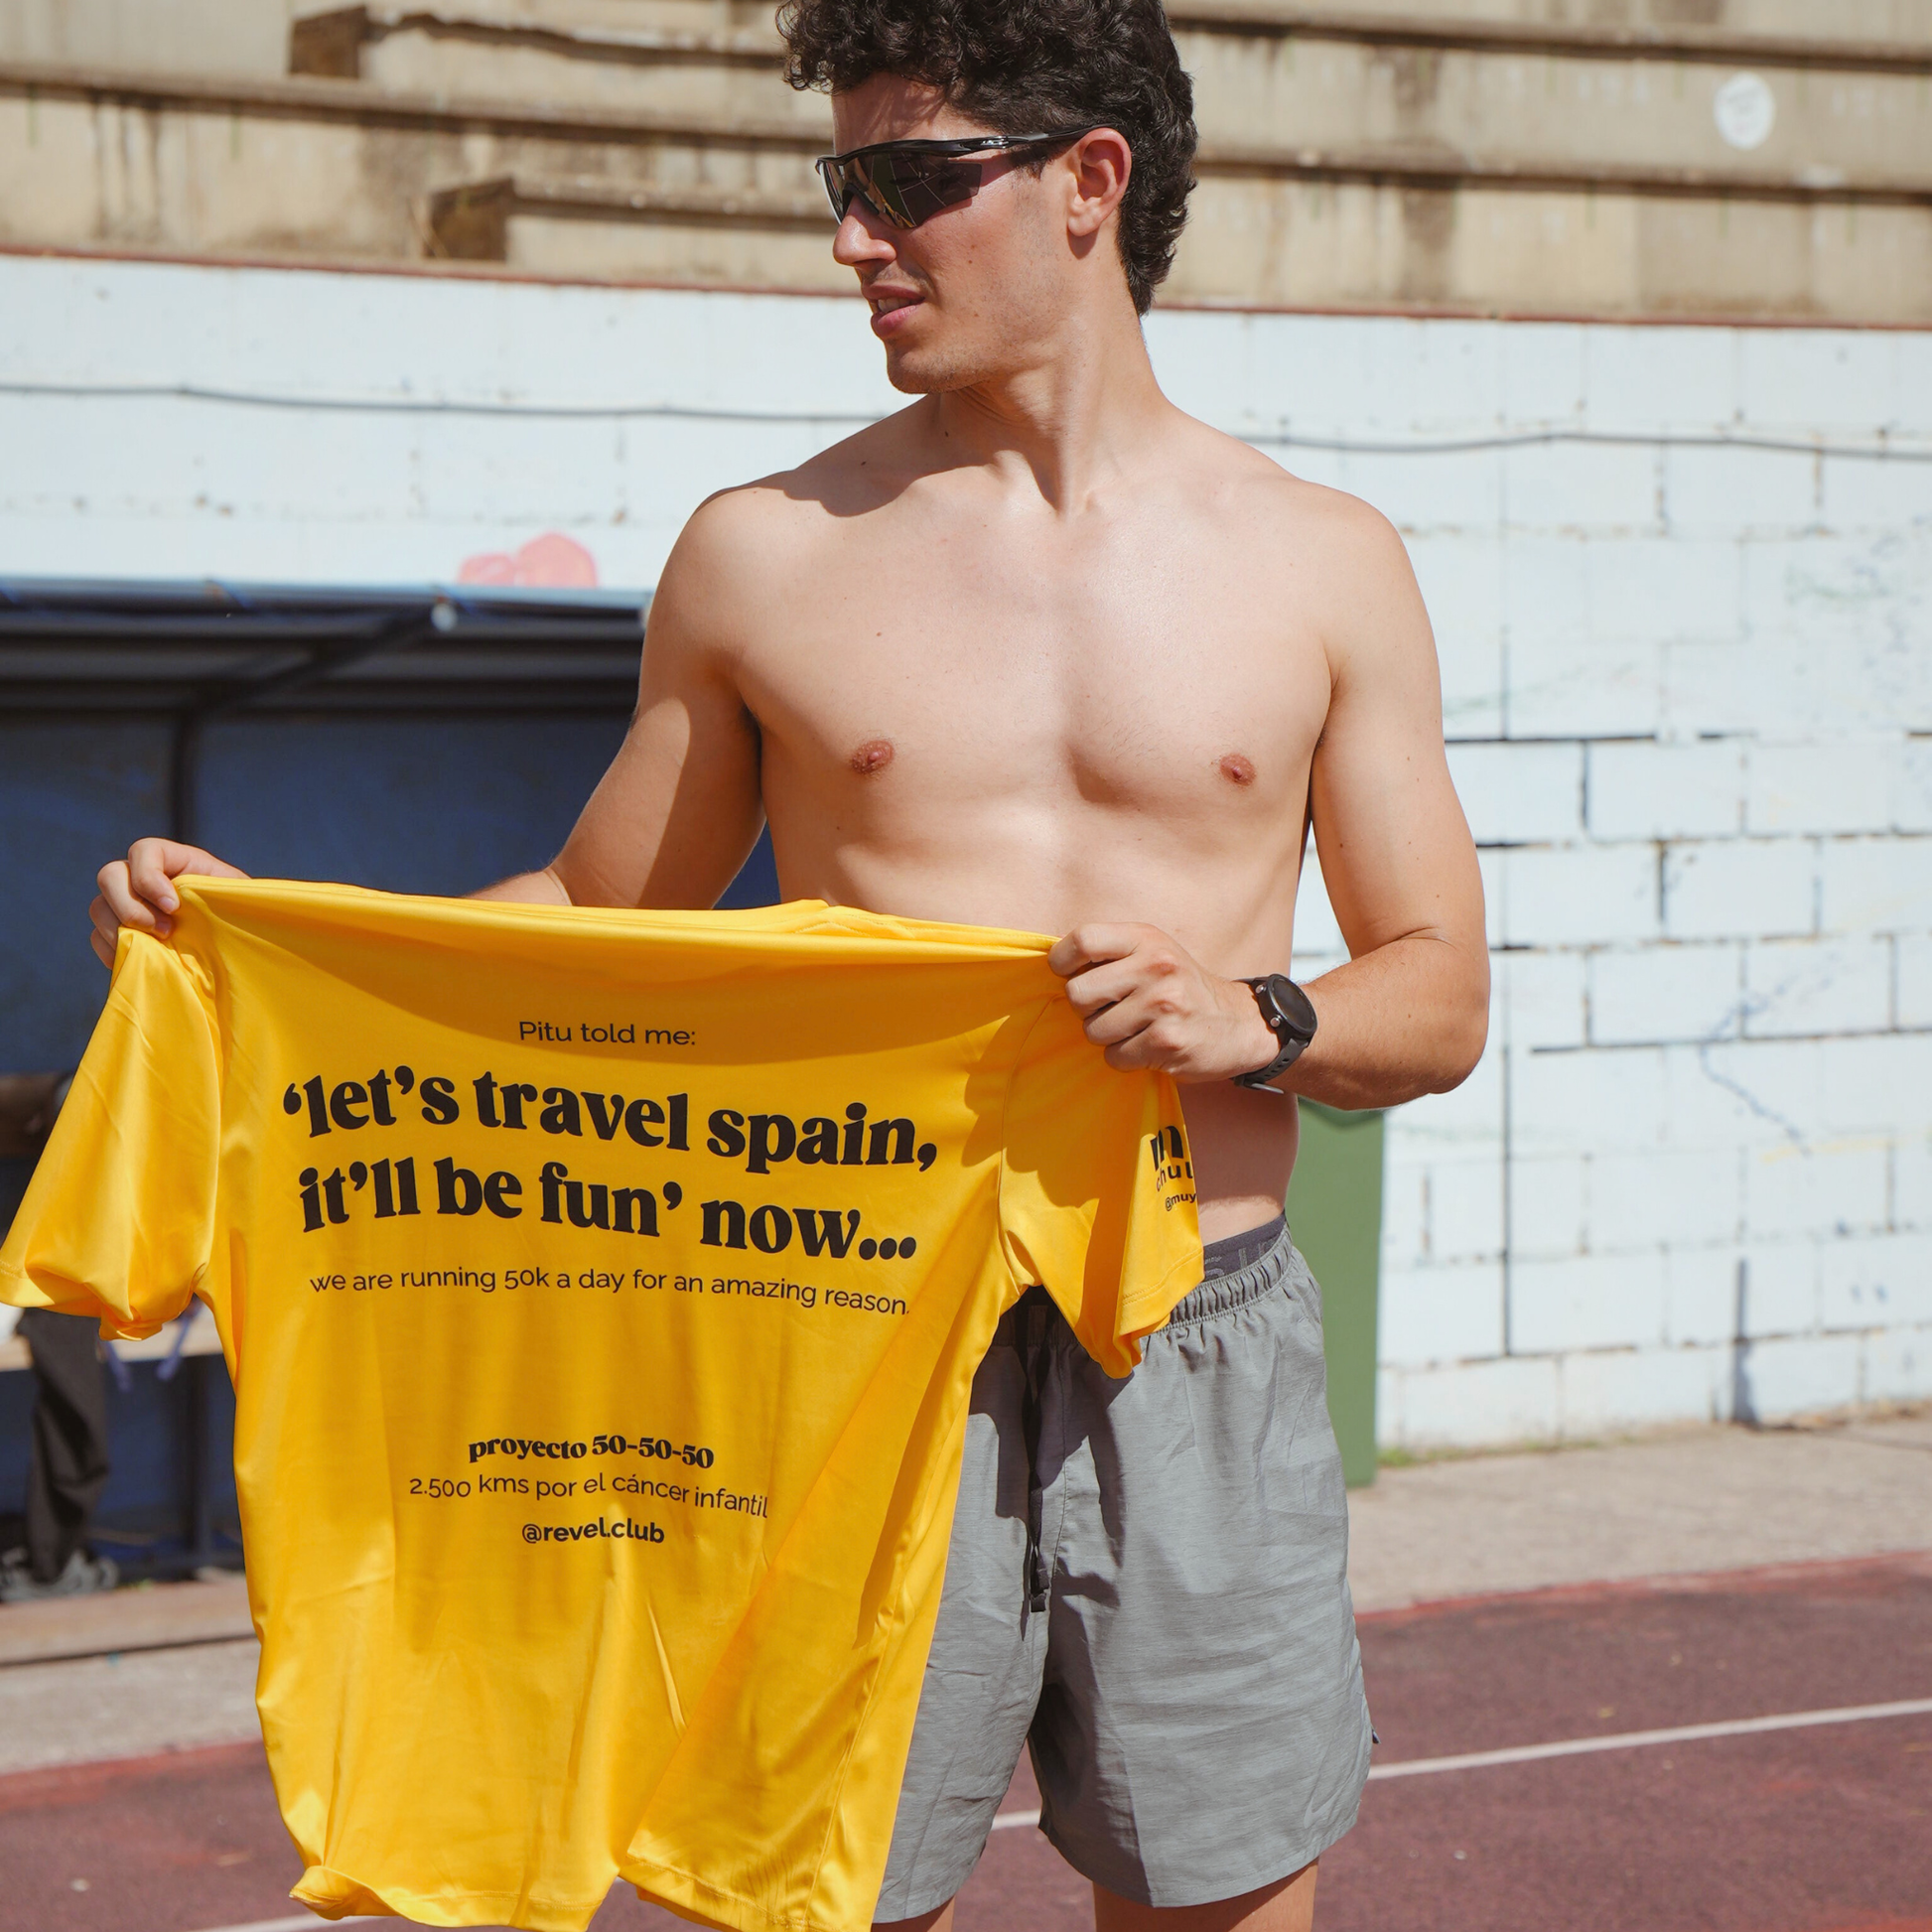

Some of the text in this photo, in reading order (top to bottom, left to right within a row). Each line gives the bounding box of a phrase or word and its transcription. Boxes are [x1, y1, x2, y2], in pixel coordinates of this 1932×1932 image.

[519, 1022, 696, 1045] Pitu told me:
[284, 1065, 937, 1174] ‘let’s travel spain,
[300, 1157, 916, 1260] it’ll be fun’ now...
[311, 1267, 910, 1314] we are running 50k a day for an amazing reason.
[470, 1435, 714, 1468] proyecto 50-50-50
[410, 1473, 767, 1518] 2.500 kms por el cáncer infantil
[522, 1517, 664, 1543] @revel.club
